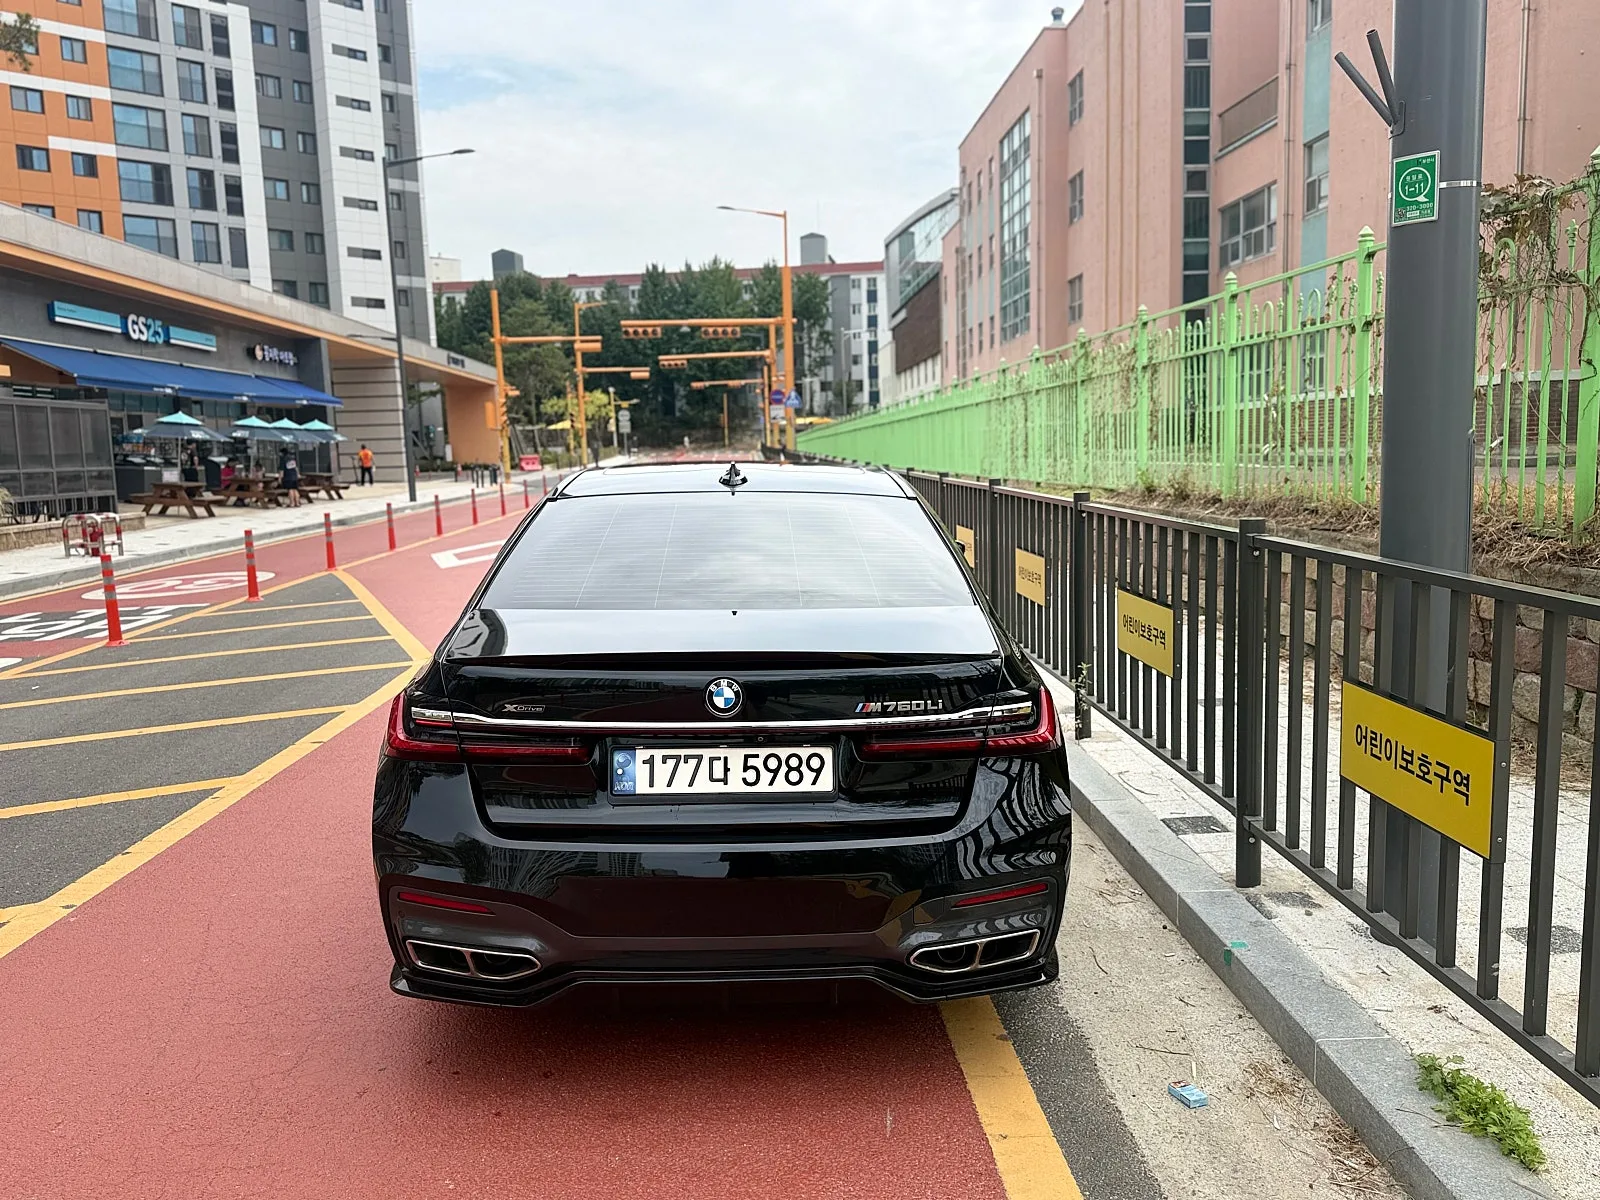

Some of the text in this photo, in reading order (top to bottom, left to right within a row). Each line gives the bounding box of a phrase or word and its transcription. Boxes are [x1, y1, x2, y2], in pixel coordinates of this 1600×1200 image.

[1405, 182, 1424, 196] 1-11
[127, 313, 164, 344] GS25
[1122, 613, 1166, 651] 어린이보호구역
[709, 680, 739, 692] BMW
[642, 752, 826, 788] 177다 5989
[1355, 724, 1471, 807] 어린이보호구역
